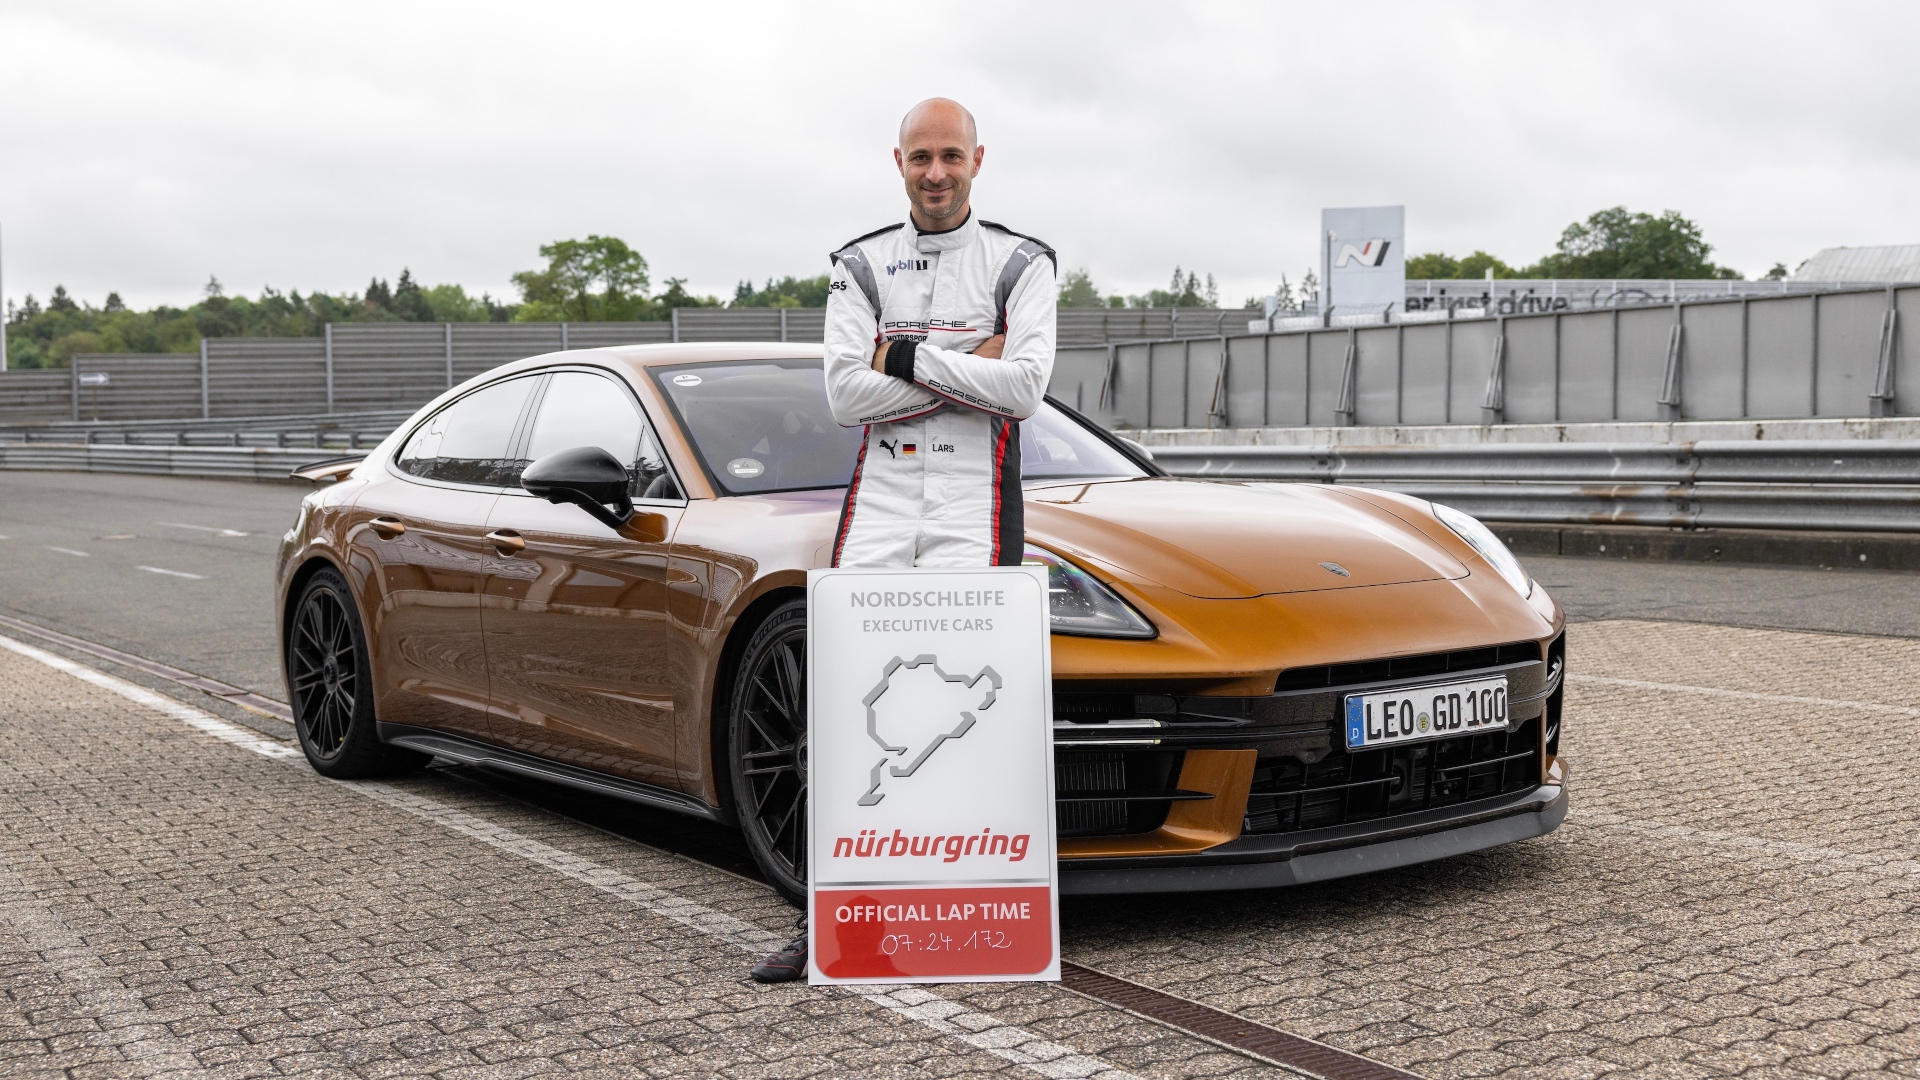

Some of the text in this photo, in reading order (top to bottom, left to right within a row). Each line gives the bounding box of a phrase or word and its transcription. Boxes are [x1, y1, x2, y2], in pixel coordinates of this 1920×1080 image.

[885, 318, 967, 329] PORSCHE
[928, 379, 1015, 415] PORSCHE
[932, 443, 955, 453] LARS
[850, 590, 1005, 608] NORDSCHLEIFE
[754, 611, 792, 646] MICHELIN
[863, 618, 994, 632] EXECUTIVE CARS
[1366, 686, 1506, 740] LEO GD 100
[1352, 727, 1359, 739] D
[833, 828, 1031, 863] nürburgring
[835, 902, 1031, 923] OFFICIAL LAP TIME
[881, 930, 1012, 955] 07:24.172
